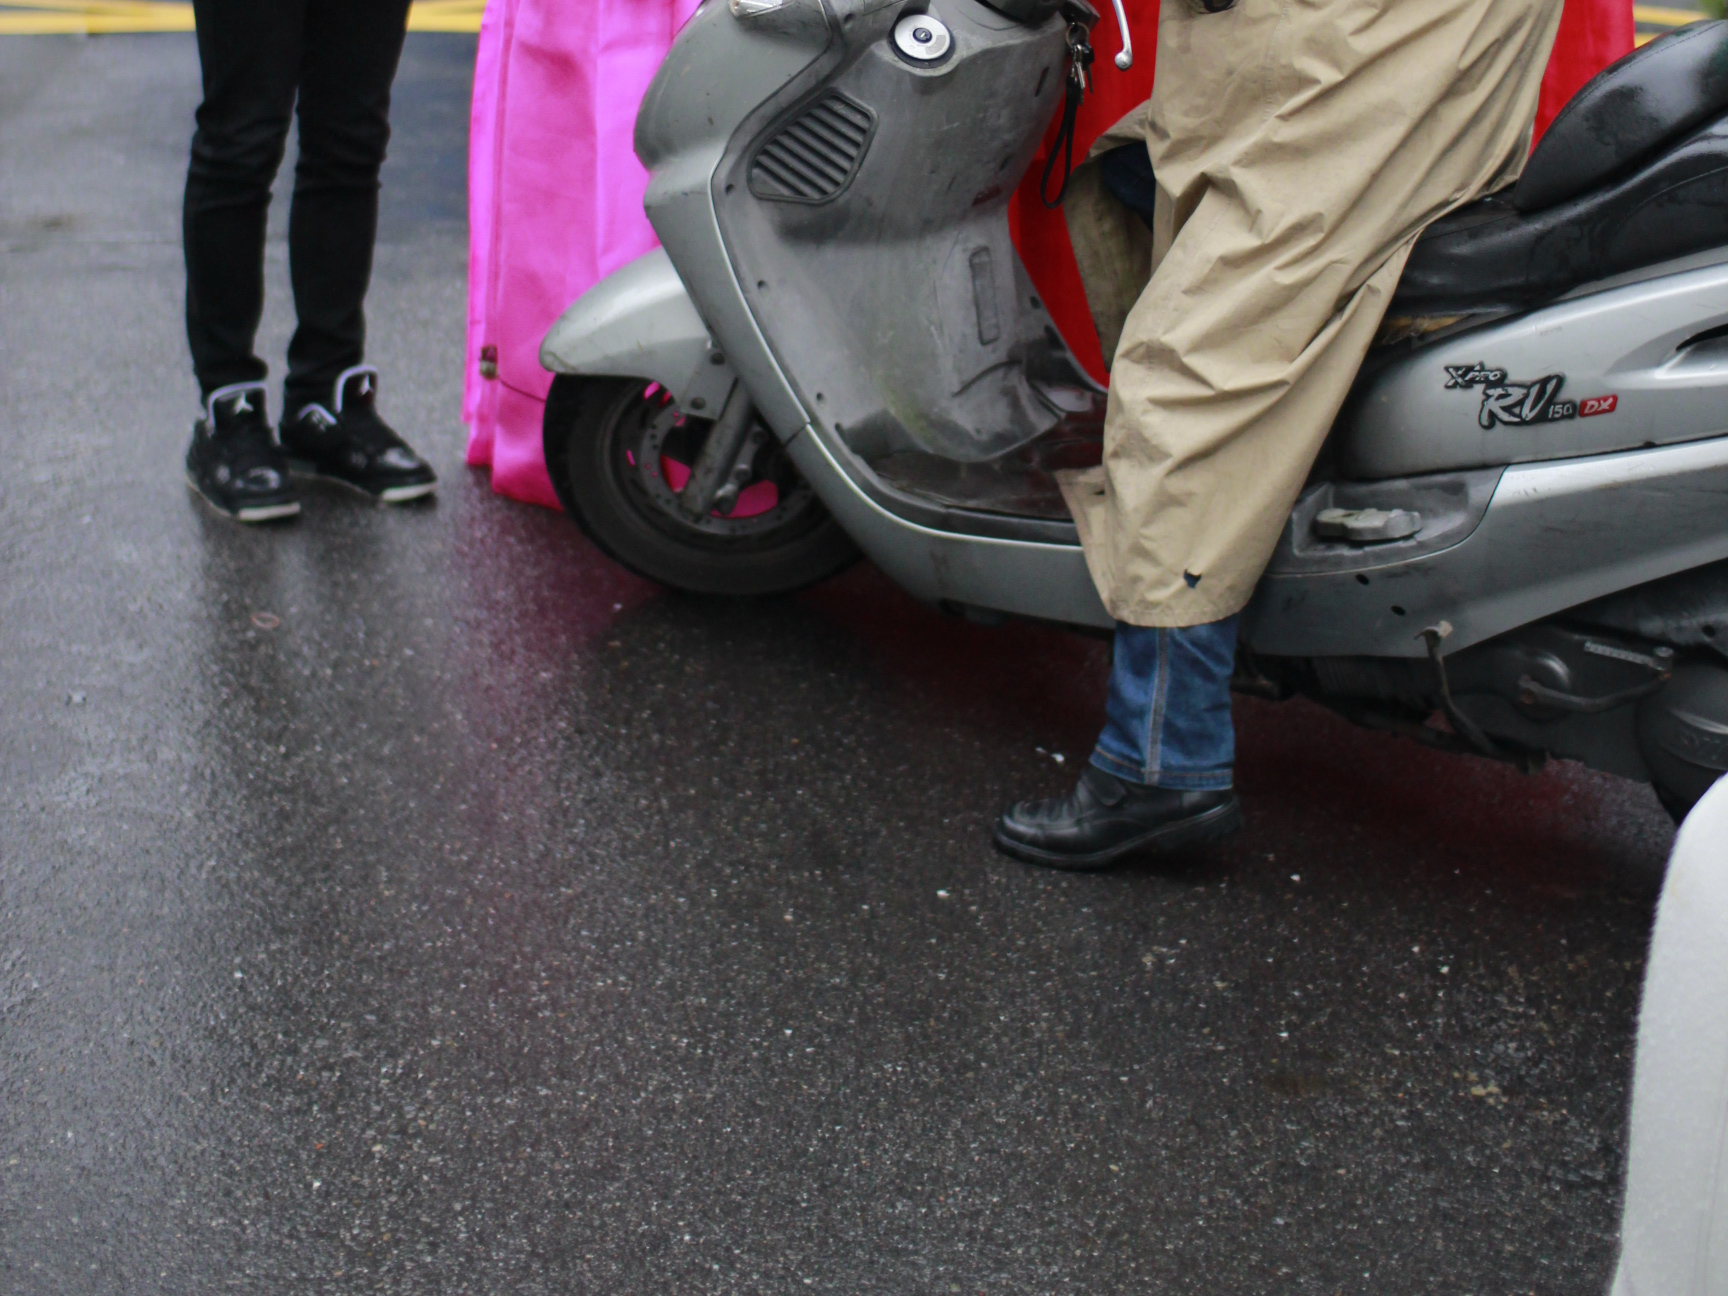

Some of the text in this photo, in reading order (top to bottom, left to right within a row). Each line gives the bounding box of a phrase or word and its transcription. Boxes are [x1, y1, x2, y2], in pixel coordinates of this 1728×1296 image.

[1480, 375, 1614, 427] RV 150 DX
